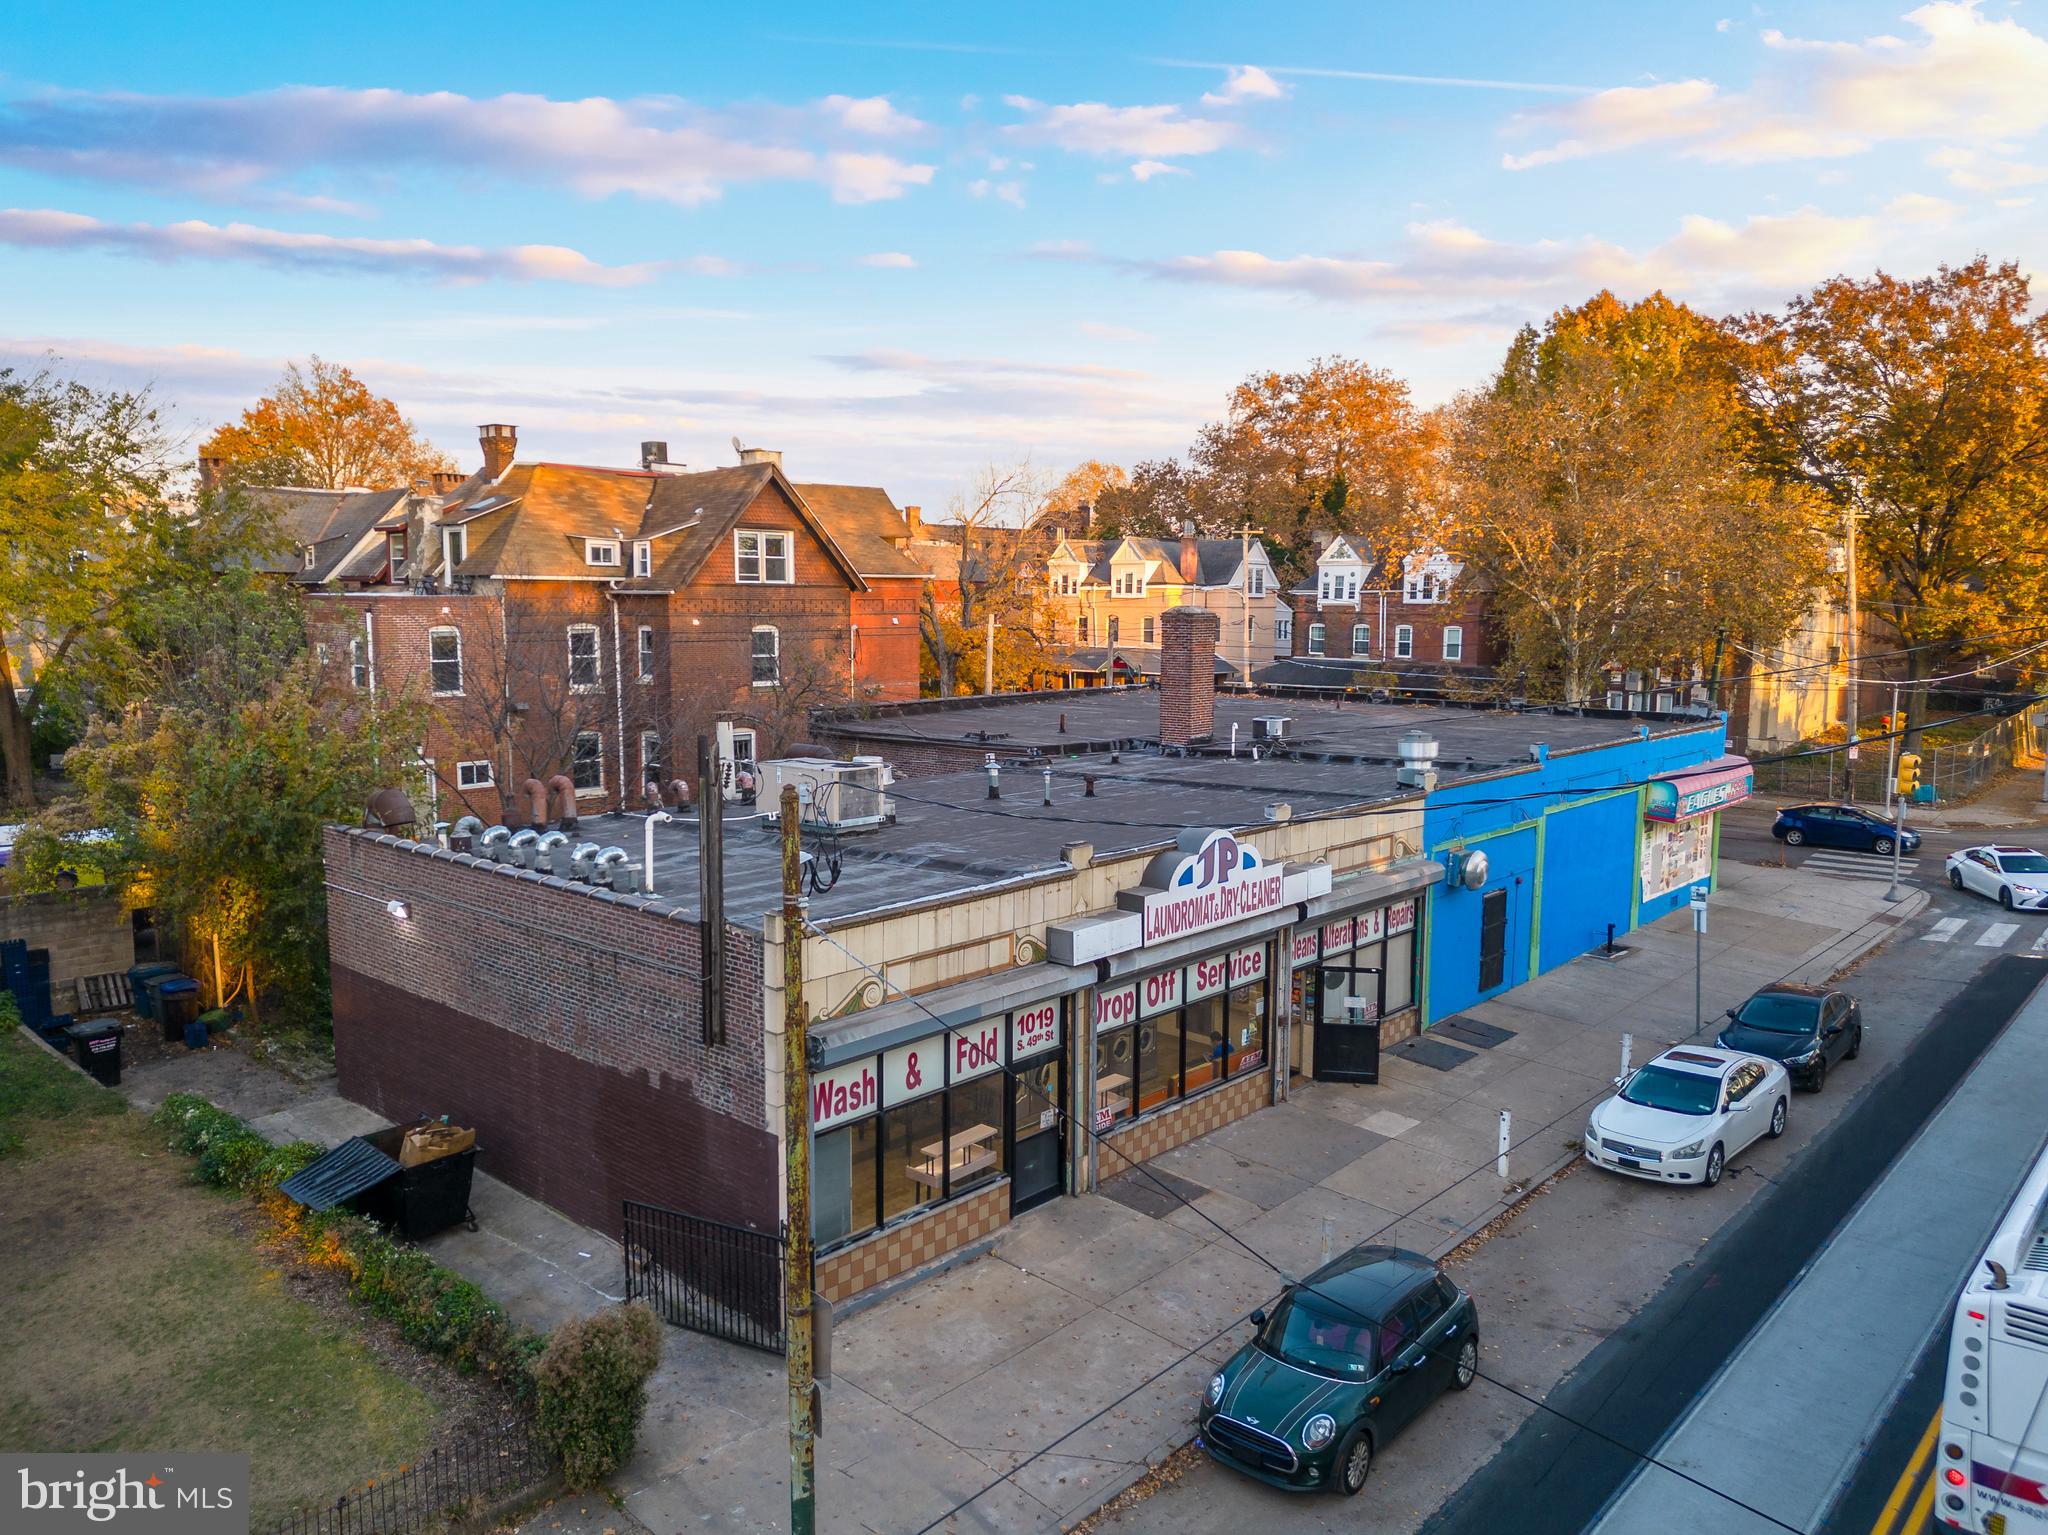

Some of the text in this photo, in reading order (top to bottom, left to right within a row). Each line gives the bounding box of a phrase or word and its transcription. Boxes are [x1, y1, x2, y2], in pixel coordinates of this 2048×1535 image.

[1686, 785, 1726, 812] EAGLES
[1197, 837, 1239, 889] JP
[1291, 934, 1317, 960] leans
[1373, 909, 1380, 935] &
[1387, 898, 1414, 934] Repairs
[1146, 970, 1176, 1008] Off
[1197, 950, 1262, 991] Service
[1017, 1006, 1054, 1036] 1019
[1027, 1032, 1043, 1047] 49th
[814, 1027, 998, 1123] Wash & Fold
